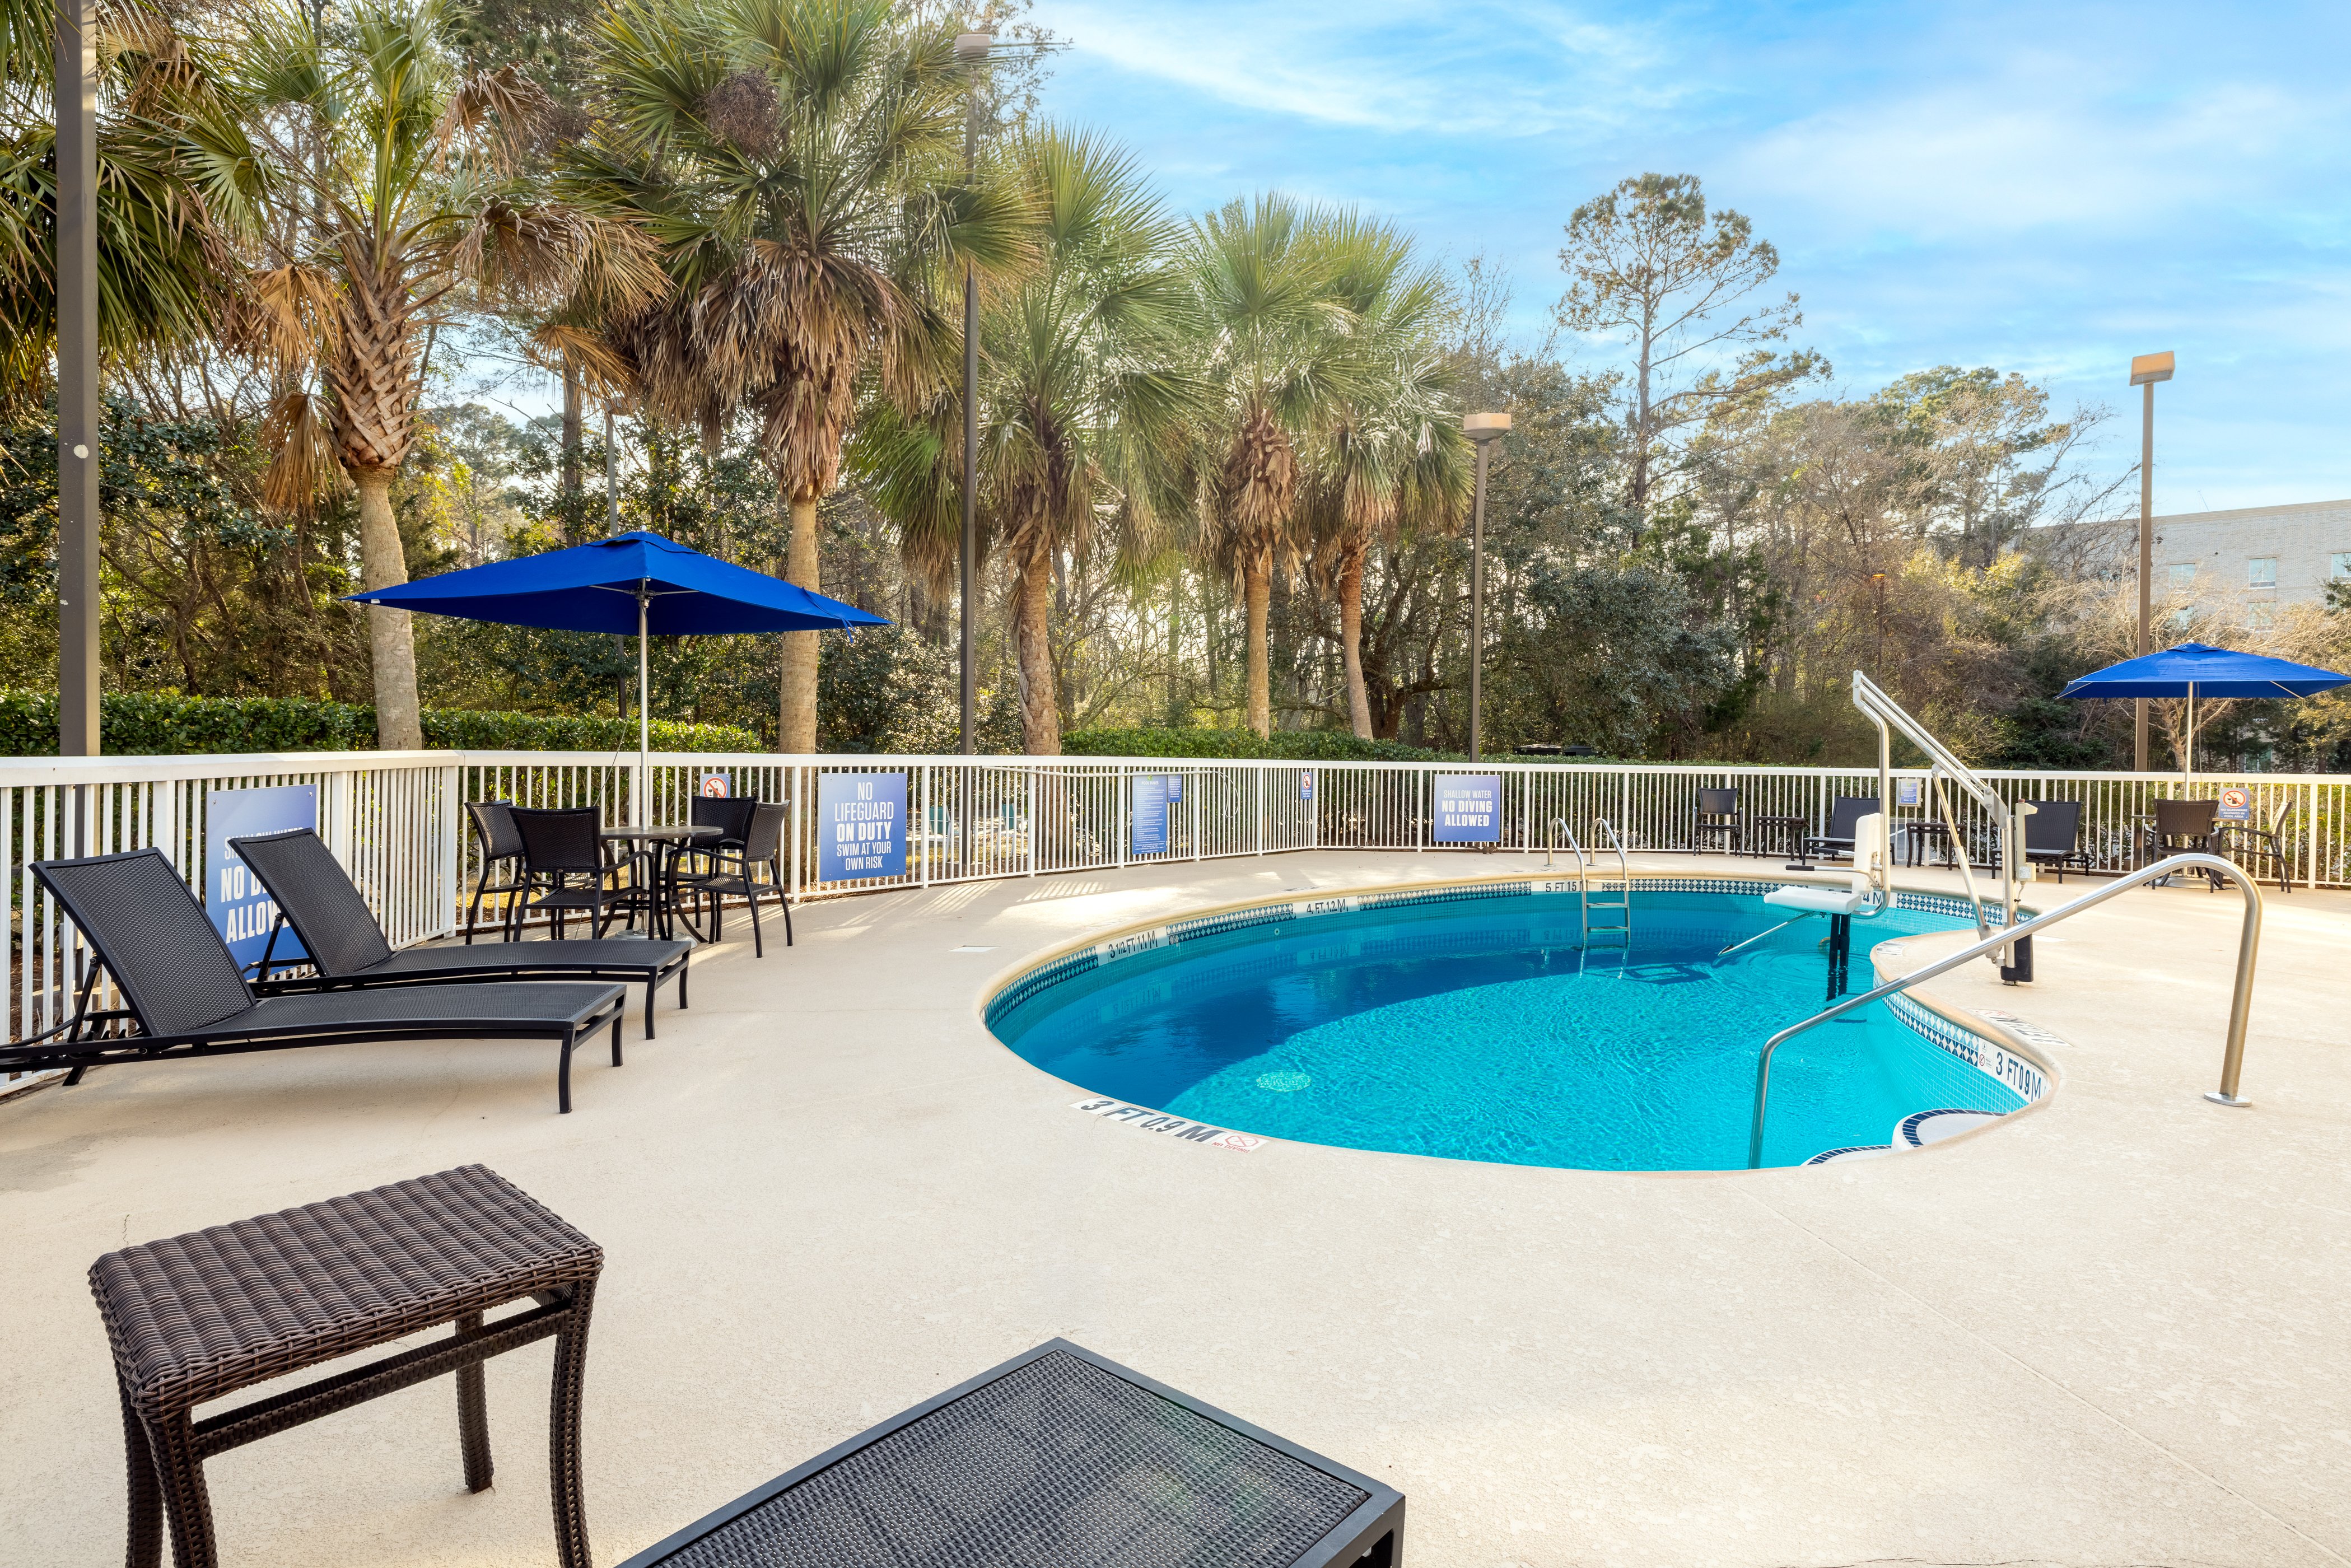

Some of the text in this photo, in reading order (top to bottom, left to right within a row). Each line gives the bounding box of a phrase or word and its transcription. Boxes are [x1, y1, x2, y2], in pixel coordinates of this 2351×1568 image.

[857, 782, 873, 800] NO
[1444, 790, 1491, 799] SHALLOW WATER
[835, 801, 894, 822] LIFEGUARD
[1442, 800, 1492, 813] NO DIVING
[1444, 814, 1489, 827] ALLOWED
[837, 822, 892, 842] ON DUTY
[837, 841, 892, 857] SWIM AT YOUR
[846, 856, 883, 871] OWN RISK
[221, 865, 245, 903] NO
[1546, 883, 1551, 892] 5
[1555, 882, 1565, 892] FT
[1315, 902, 1326, 913] FT
[1337, 898, 1349, 912] M
[226, 900, 290, 944] ALLOW
[1108, 944, 1116, 958] 3
[1126, 937, 1136, 954] FT
[1147, 930, 1158, 949] M
[1996, 1052, 2003, 1075] 3
[2007, 1058, 2018, 1085] FT
[2031, 1072, 2041, 1102] M
[1080, 1100, 1228, 1142] 3 FT 0.9 M
[1224, 1144, 1250, 1154] DIVING
